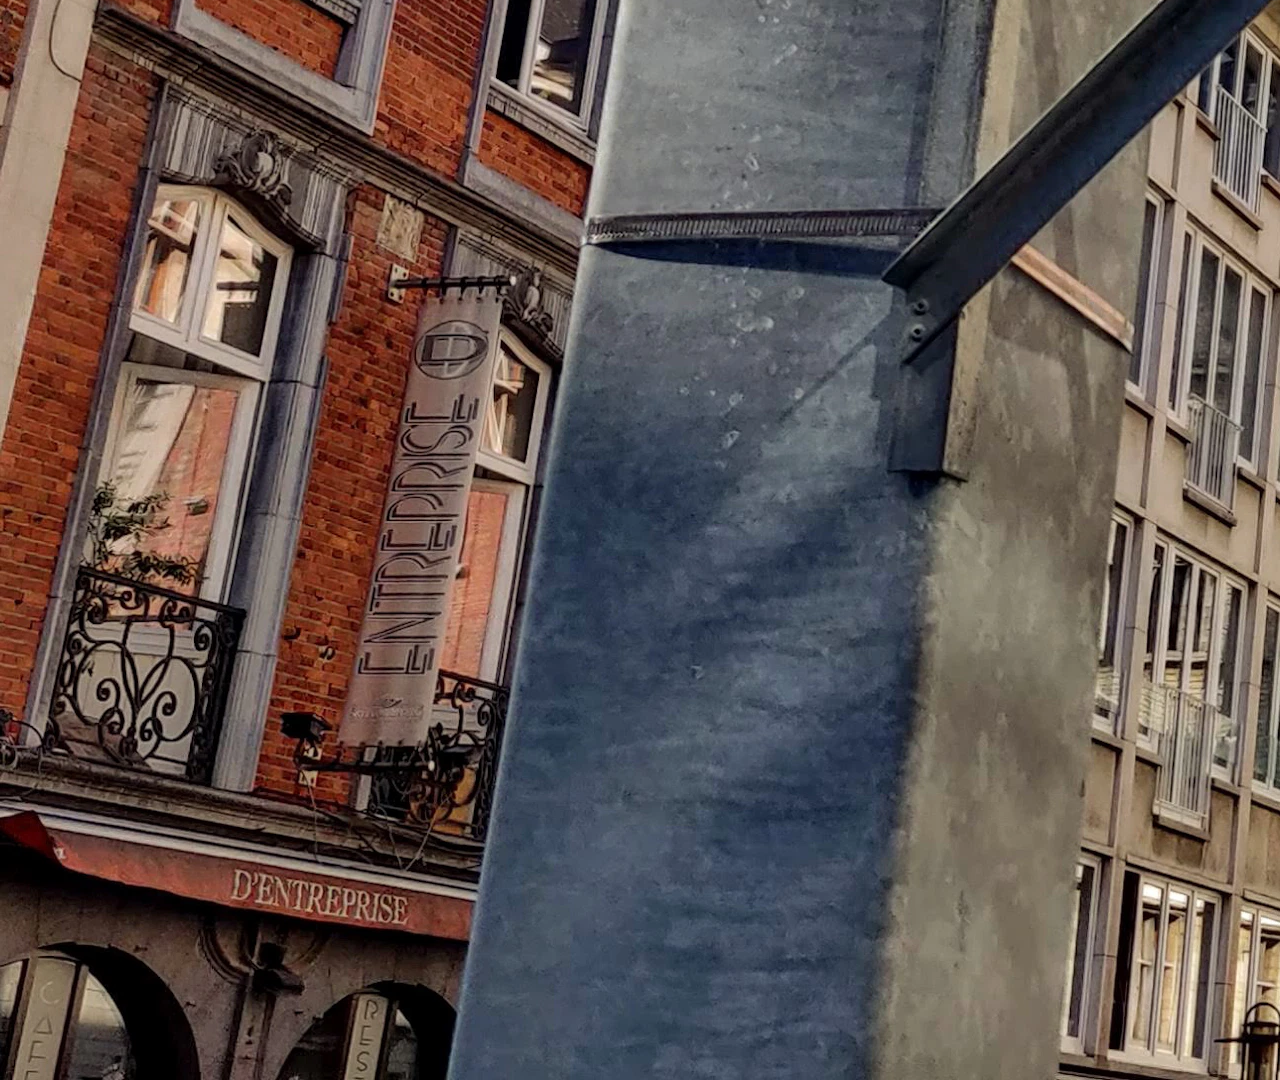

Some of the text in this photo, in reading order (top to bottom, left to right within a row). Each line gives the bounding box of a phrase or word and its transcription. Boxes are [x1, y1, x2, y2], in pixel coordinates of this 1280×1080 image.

[357, 393, 480, 674] ENTREPRISE
[231, 869, 412, 925] D'ENTREPRISE
[353, 999, 379, 1080] RES
